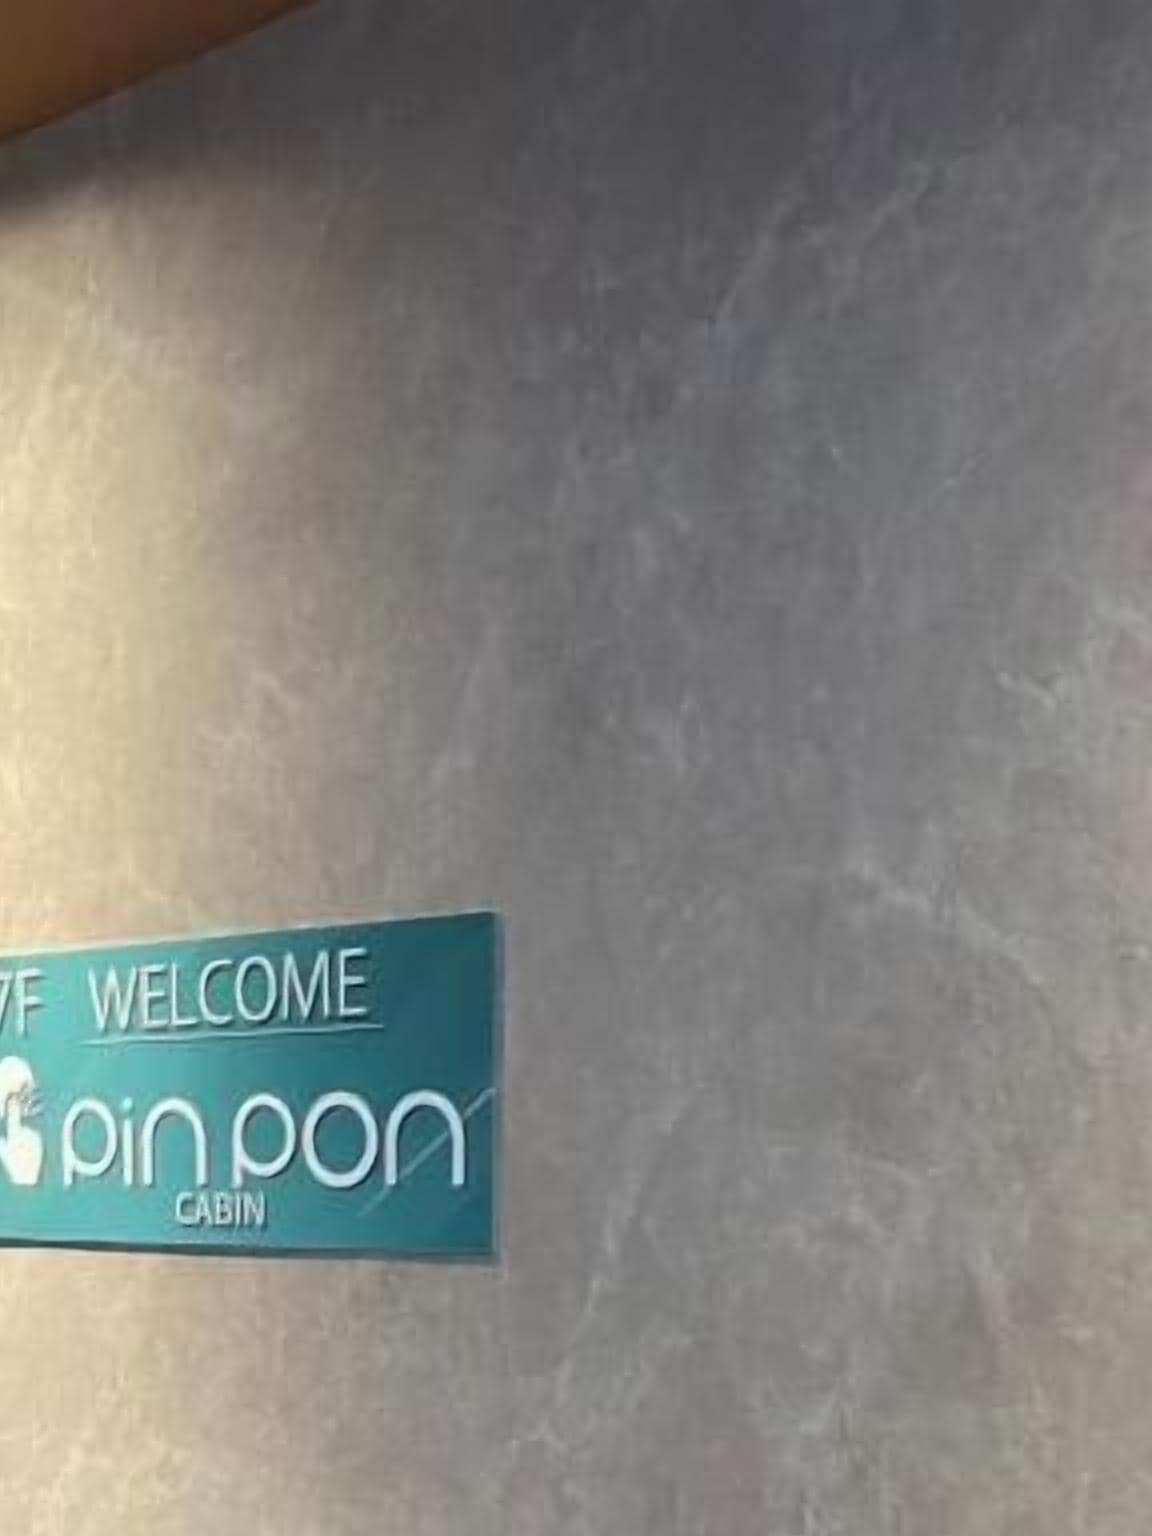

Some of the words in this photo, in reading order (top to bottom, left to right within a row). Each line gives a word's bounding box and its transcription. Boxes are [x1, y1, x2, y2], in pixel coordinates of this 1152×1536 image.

[86, 947, 369, 1032] WELCOME
[61, 1097, 208, 1187] pin
[232, 1089, 465, 1188] pon
[174, 1192, 267, 1226] CABIN
